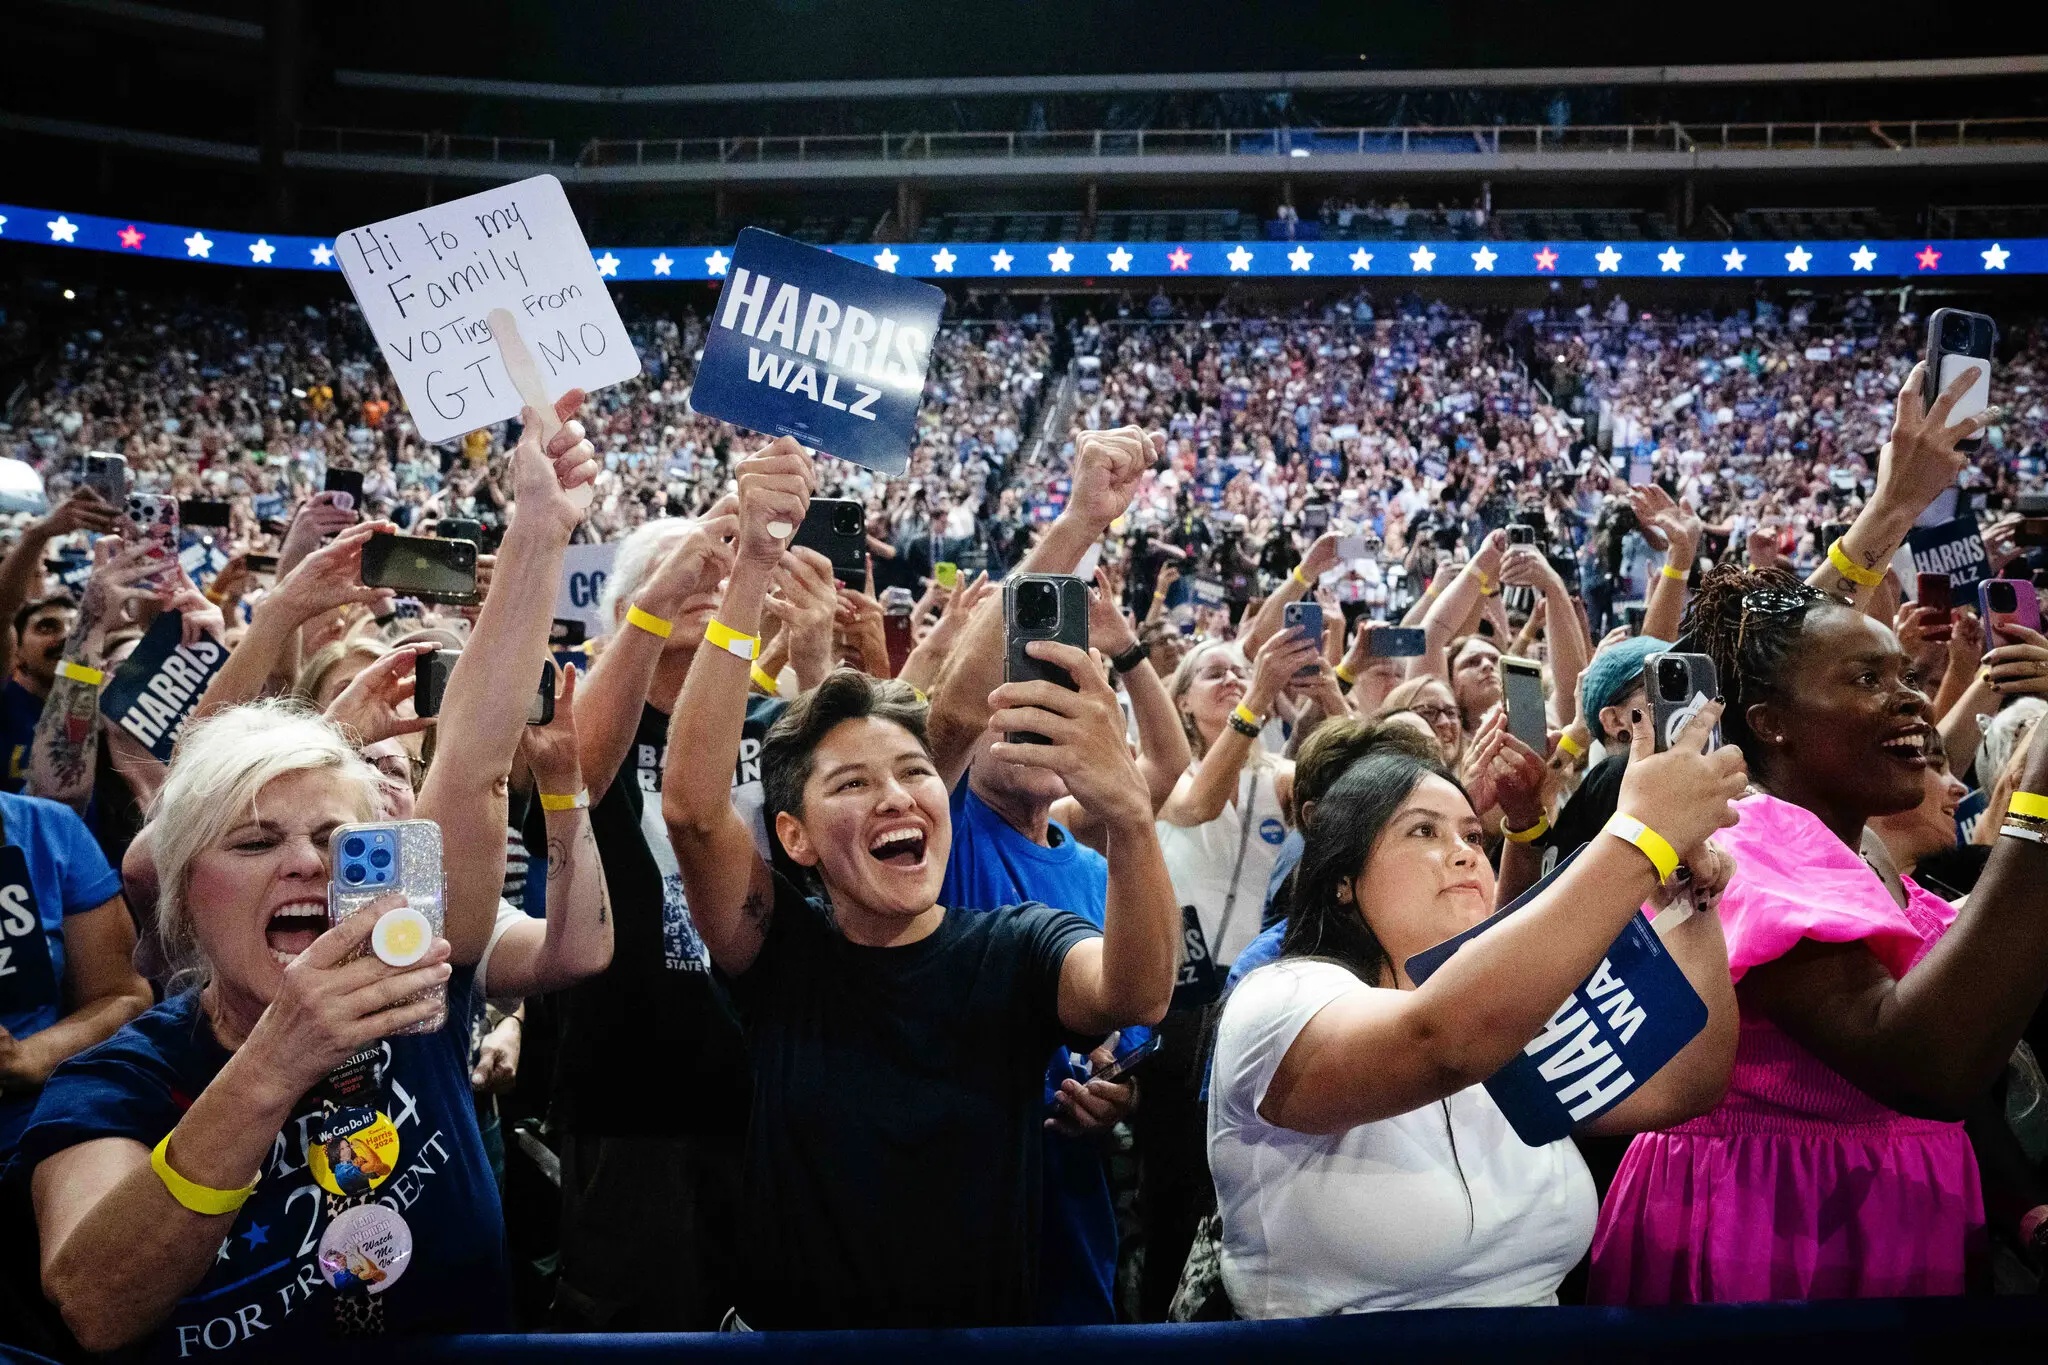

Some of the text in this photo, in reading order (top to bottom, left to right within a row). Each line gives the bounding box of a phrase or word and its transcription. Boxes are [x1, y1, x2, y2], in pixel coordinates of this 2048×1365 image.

[351, 201, 533, 274] Hi to my
[387, 249, 529, 319] Family
[521, 284, 583, 317] From
[720, 267, 927, 384] HARRIS
[425, 322, 607, 420] GT MO
[748, 347, 882, 421] WALZ
[1914, 534, 1986, 573] HARRIS
[1950, 566, 1981, 589] ALZ
[120, 641, 220, 748] HARRIS
[1585, 957, 1648, 1046] WA
[1523, 993, 1636, 1122] HAR
[318, 1112, 374, 1143] We Can Do It!
[366, 1130, 393, 1145] Harris
[374, 1138, 394, 1149] 2024
[351, 1219, 391, 1244] Woman
[362, 1231, 393, 1252] Watch
[374, 1245, 394, 1259] Me
[175, 1303, 272, 1358] FOR
